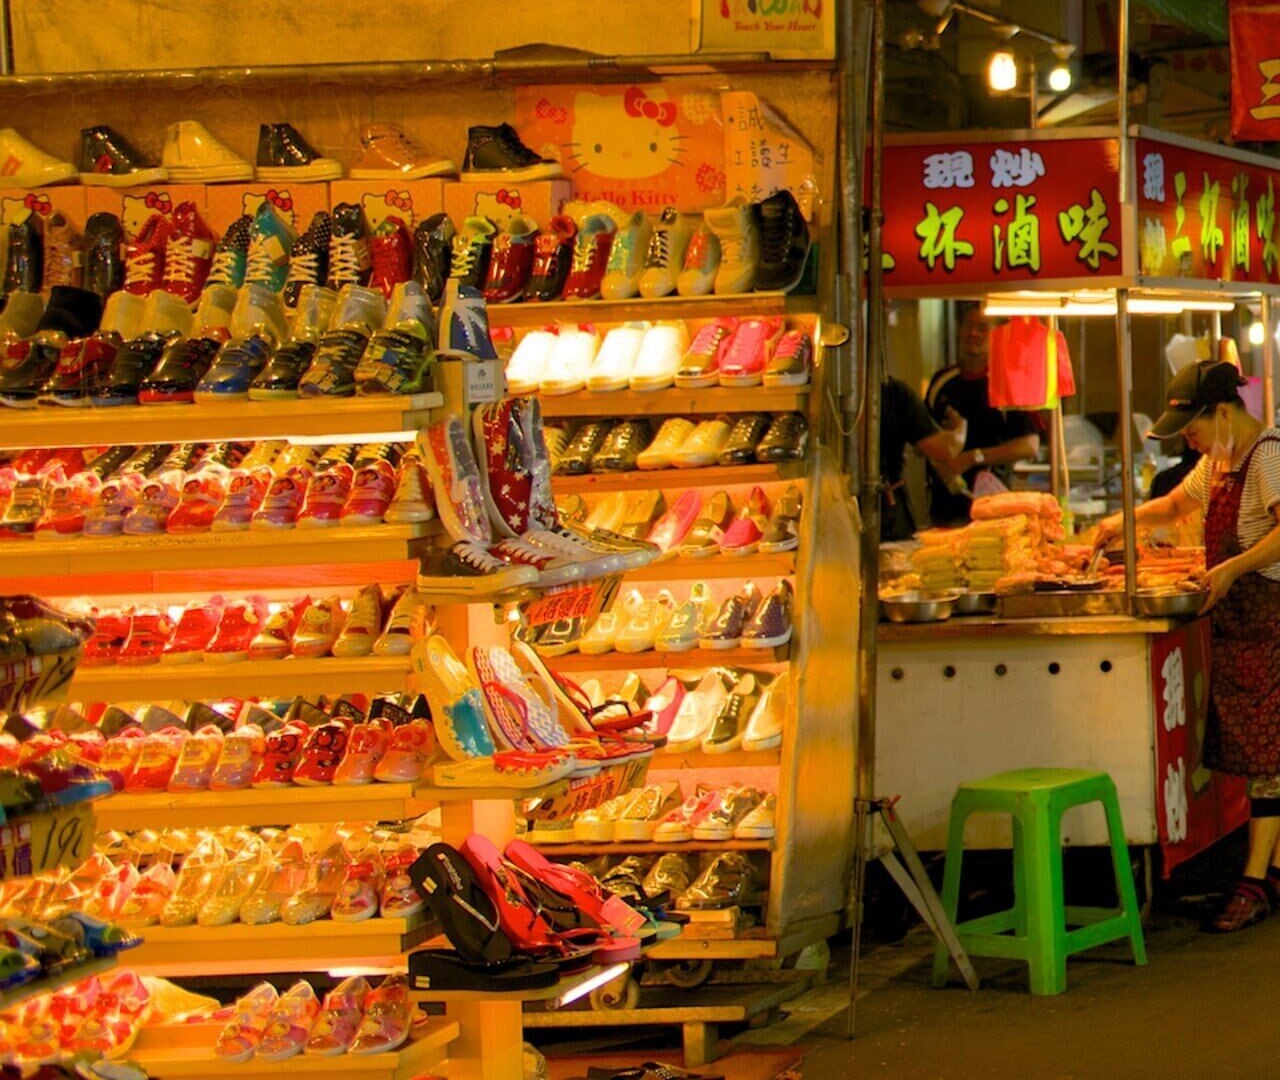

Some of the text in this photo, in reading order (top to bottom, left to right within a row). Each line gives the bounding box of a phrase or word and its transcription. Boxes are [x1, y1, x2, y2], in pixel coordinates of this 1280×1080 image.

[733, 20, 818, 32] Touch Your Heart
[923, 148, 1046, 190] 現炒
[631, 189, 680, 207] Kitty
